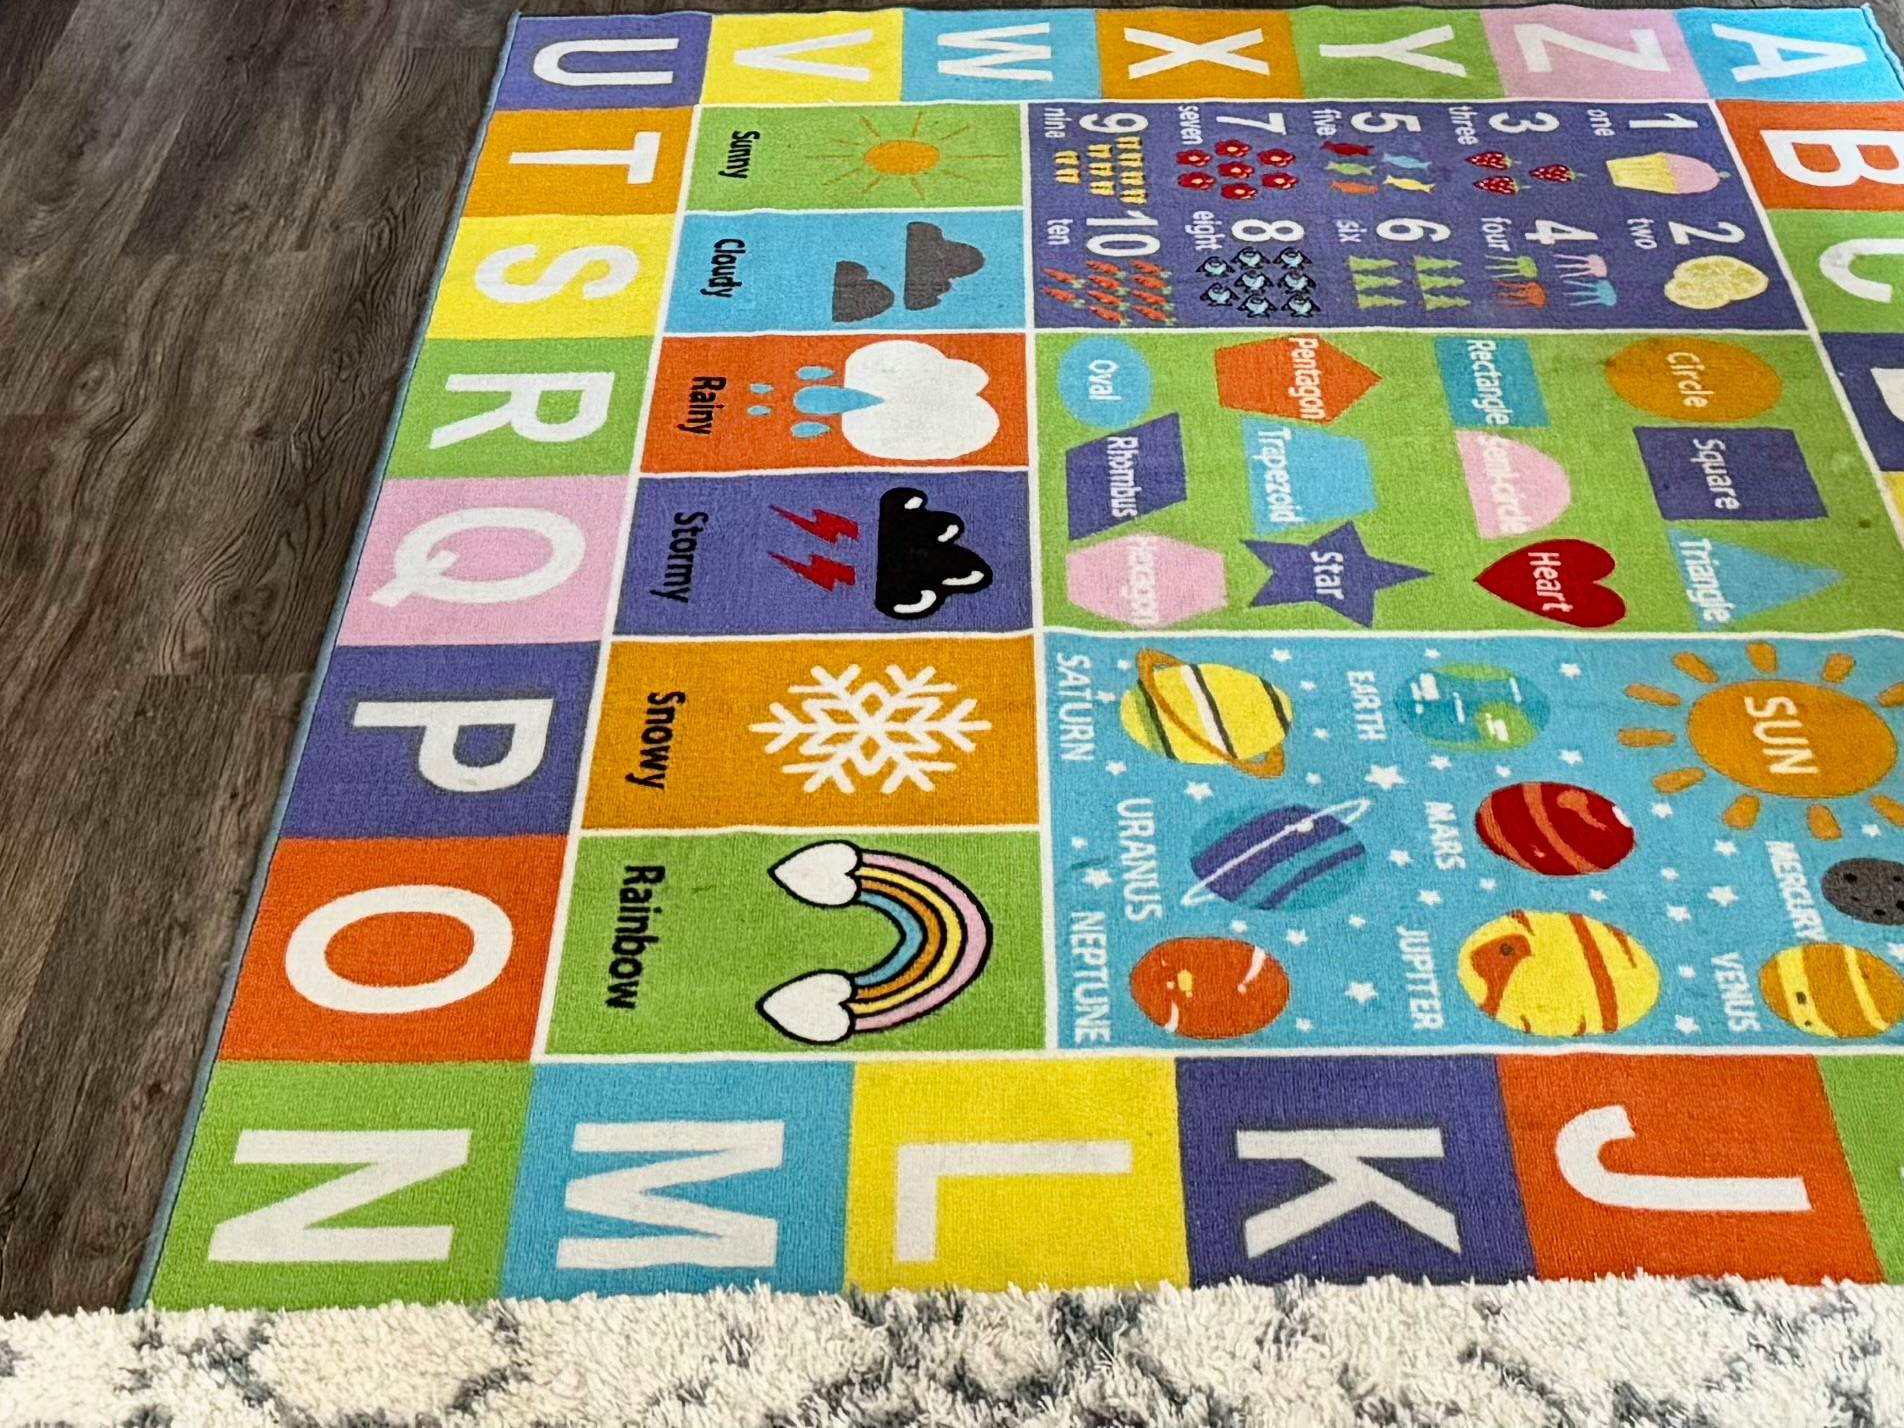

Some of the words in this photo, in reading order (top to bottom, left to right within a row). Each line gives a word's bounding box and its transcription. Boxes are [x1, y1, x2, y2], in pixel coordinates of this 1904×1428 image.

[533, 38, 680, 86] U
[733, 30, 873, 82] V
[936, 22, 1053, 82] W
[1125, 27, 1271, 81] X
[1317, 24, 1467, 78] Y
[1511, 21, 1668, 75] Z
[1709, 24, 1868, 85] A
[1043, 106, 1075, 140] nine
[1079, 111, 1149, 134] 9
[1178, 104, 1204, 146] seven
[1216, 111, 1287, 136] 7
[1311, 108, 1343, 137] five
[1350, 111, 1422, 134] 5
[1446, 104, 1479, 146] three
[1488, 111, 1560, 134] 3
[1586, 107, 1616, 138] one
[1628, 112, 1699, 129] 1
[508, 132, 662, 186] T
[717, 129, 760, 180] Sunny
[1046, 217, 1075, 247] ten
[1085, 210, 1161, 258] 10
[1184, 209, 1226, 252] eight
[1231, 218, 1305, 243] 8
[1335, 219, 1369, 244] six
[1376, 217, 1452, 243] 6
[1480, 215, 1513, 254] four
[1525, 218, 1599, 245] 4
[1627, 216, 1659, 250] two
[1668, 220, 1746, 245] 2
[474, 245, 639, 305] S
[700, 237, 746, 299] Cloudy
[677, 374, 726, 436] Rainy
[1088, 358, 1122, 402] Oval
[1287, 335, 1327, 421] Pentagon
[1466, 338, 1515, 427] Rectangle
[1665, 350, 1715, 409] Circle
[428, 370, 616, 450] R
[1107, 435, 1144, 520] Rhombus
[1252, 426, 1304, 524] Trapezoid
[1692, 437, 1741, 511] Square
[370, 505, 587, 608] Q
[647, 511, 709, 604] Stormy
[1309, 550, 1346, 601] Star
[1527, 551, 1574, 614] Heart
[1678, 537, 1736, 625] Triangle
[1055, 652, 1096, 762] SATURN
[1345, 670, 1387, 741] EARTH
[1742, 695, 1820, 775] SUN
[351, 697, 553, 793] P
[624, 689, 686, 792] Snowy
[1116, 797, 1164, 922] URANUS
[1423, 800, 1466, 871] MARS
[283, 882, 514, 1016] O
[605, 863, 666, 1012] Rainbow
[1070, 911, 1112, 1044] NEPTUNE
[1396, 924, 1445, 1031] JUPITER
[1710, 951, 1761, 1033] VENUS
[1553, 1105, 1813, 1213] J
[205, 1127, 472, 1263] N
[555, 1118, 785, 1269] M
[895, 1140, 1132, 1263] L
[1234, 1125, 1462, 1257] K
